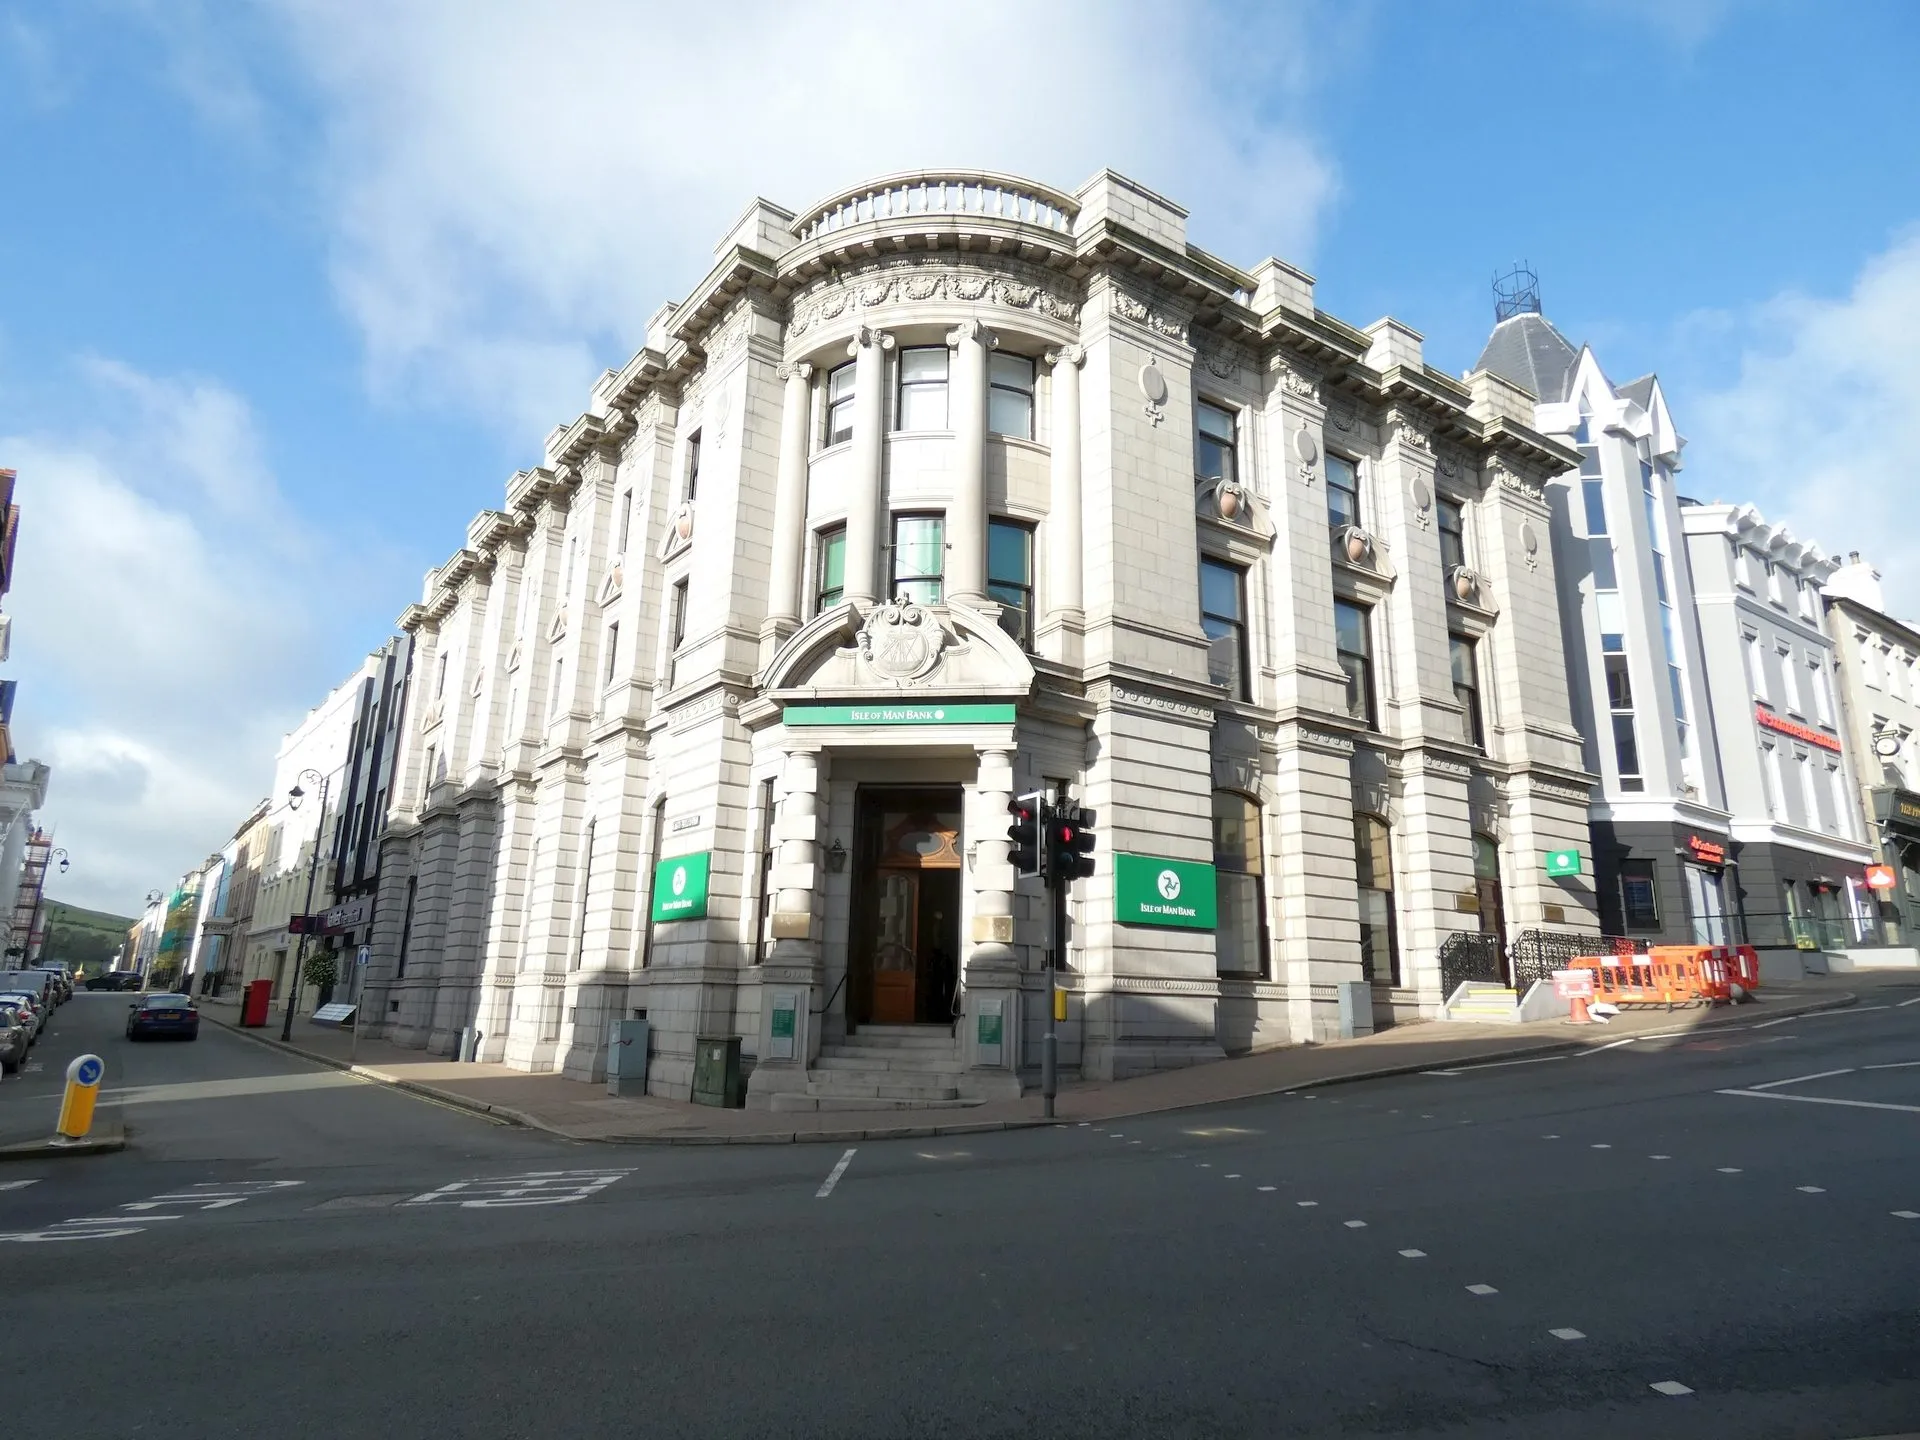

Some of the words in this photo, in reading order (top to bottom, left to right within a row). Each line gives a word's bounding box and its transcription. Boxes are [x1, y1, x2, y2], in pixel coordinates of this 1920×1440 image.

[851, 710, 869, 720] ISLE
[883, 710, 905, 720] MAN
[906, 709, 933, 720] BANK
[1141, 903, 1154, 913] ISLE
[1163, 905, 1178, 916] MAN
[1178, 907, 1196, 917] BANK
